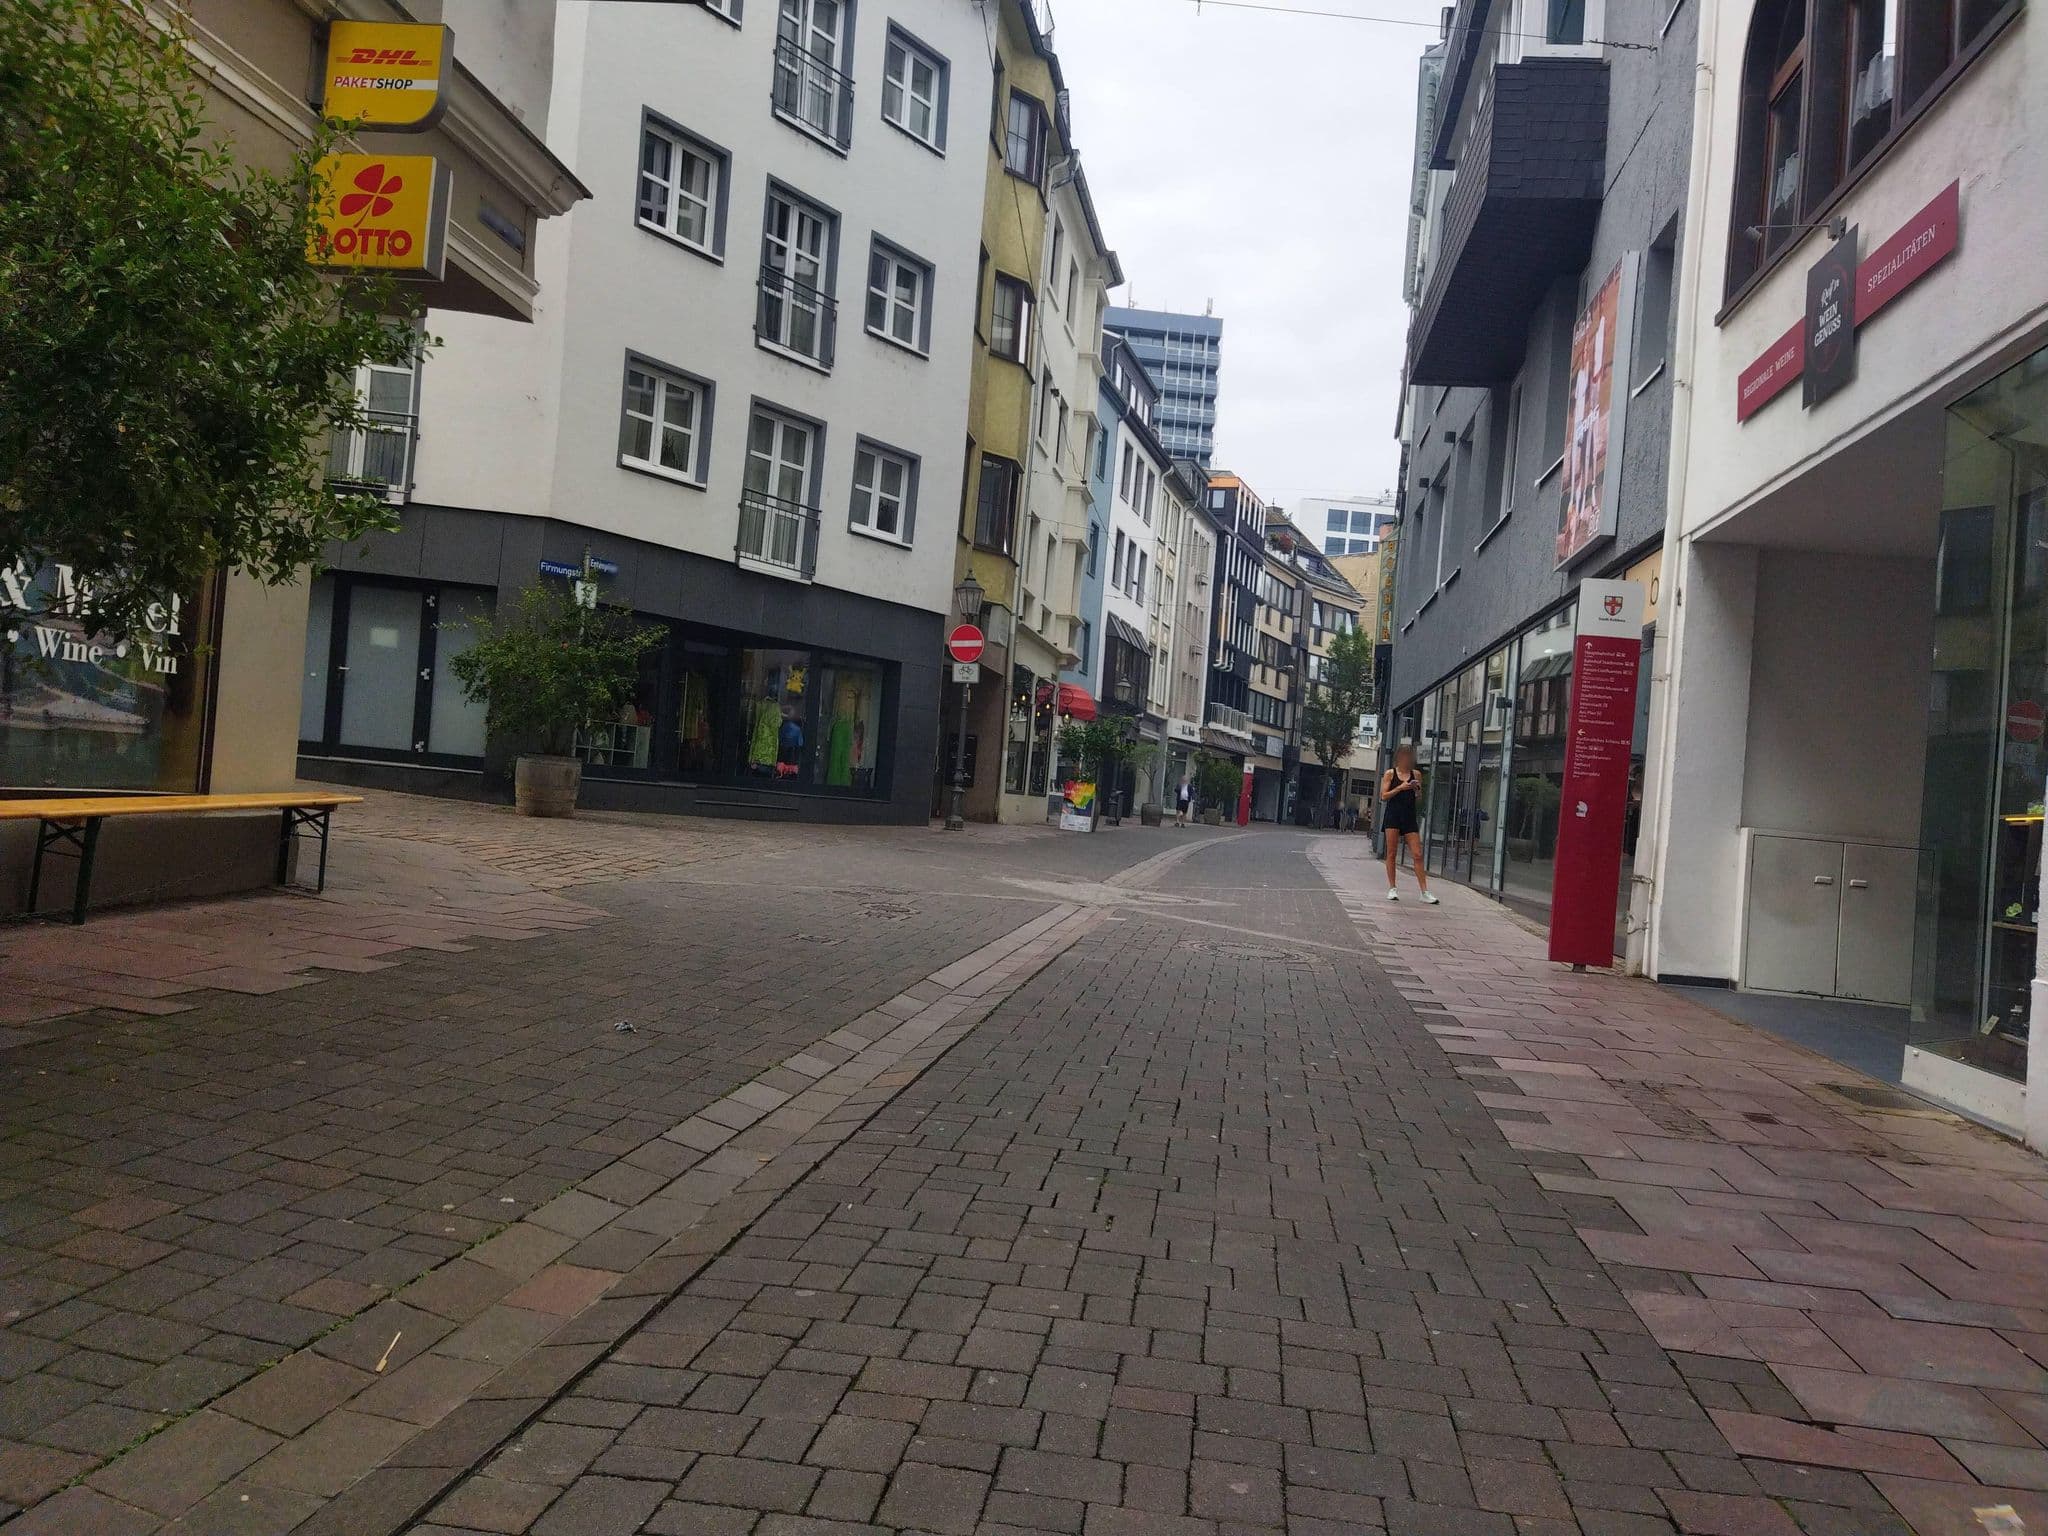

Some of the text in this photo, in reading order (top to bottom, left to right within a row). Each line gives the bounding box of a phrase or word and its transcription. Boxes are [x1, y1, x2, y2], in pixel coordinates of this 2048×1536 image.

[348, 48, 421, 66] DHL
[333, 76, 414, 90] PAKETSHOP
[1867, 223, 1937, 293] SPEZIALITÄTEN
[1819, 300, 1839, 328] WEIN
[1814, 314, 1841, 348] GENUSS
[1775, 345, 1795, 371] WEINE
[34, 624, 104, 665] Wine
[138, 641, 178, 675] Vin
